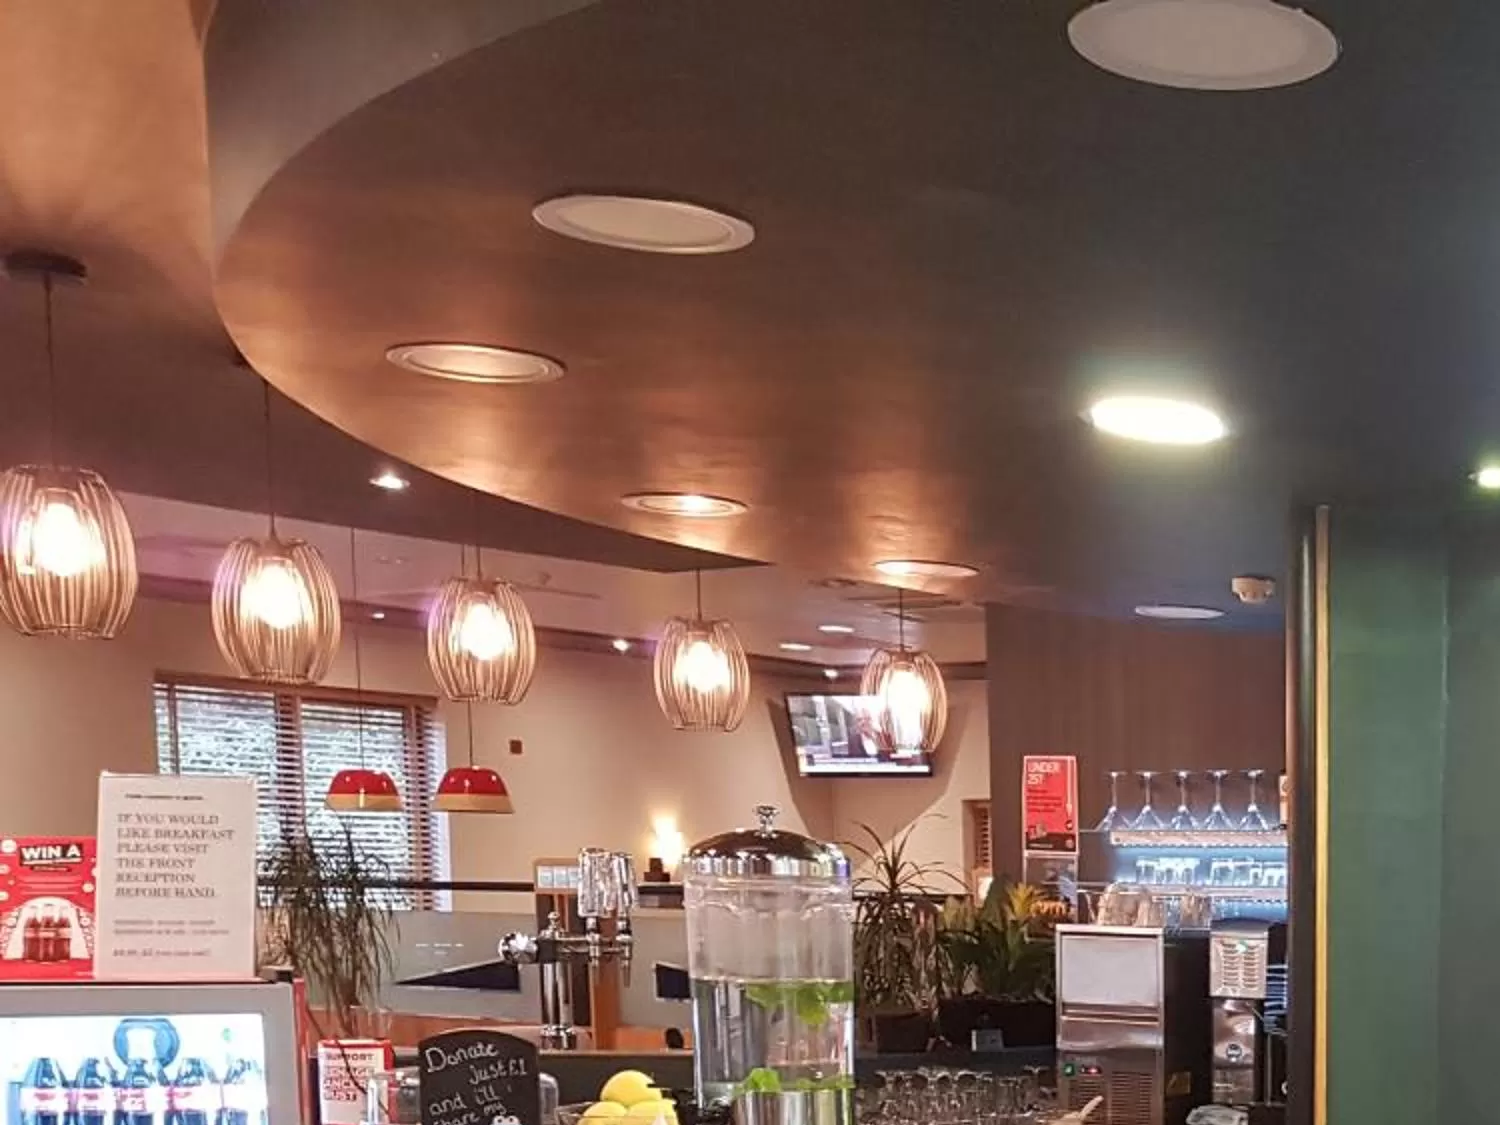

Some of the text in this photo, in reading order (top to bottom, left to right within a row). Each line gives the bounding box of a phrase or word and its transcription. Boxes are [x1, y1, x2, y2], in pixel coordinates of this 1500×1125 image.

[21, 843, 81, 860] WIN A
[425, 1041, 500, 1073] Donate
[429, 1091, 467, 1116] and
